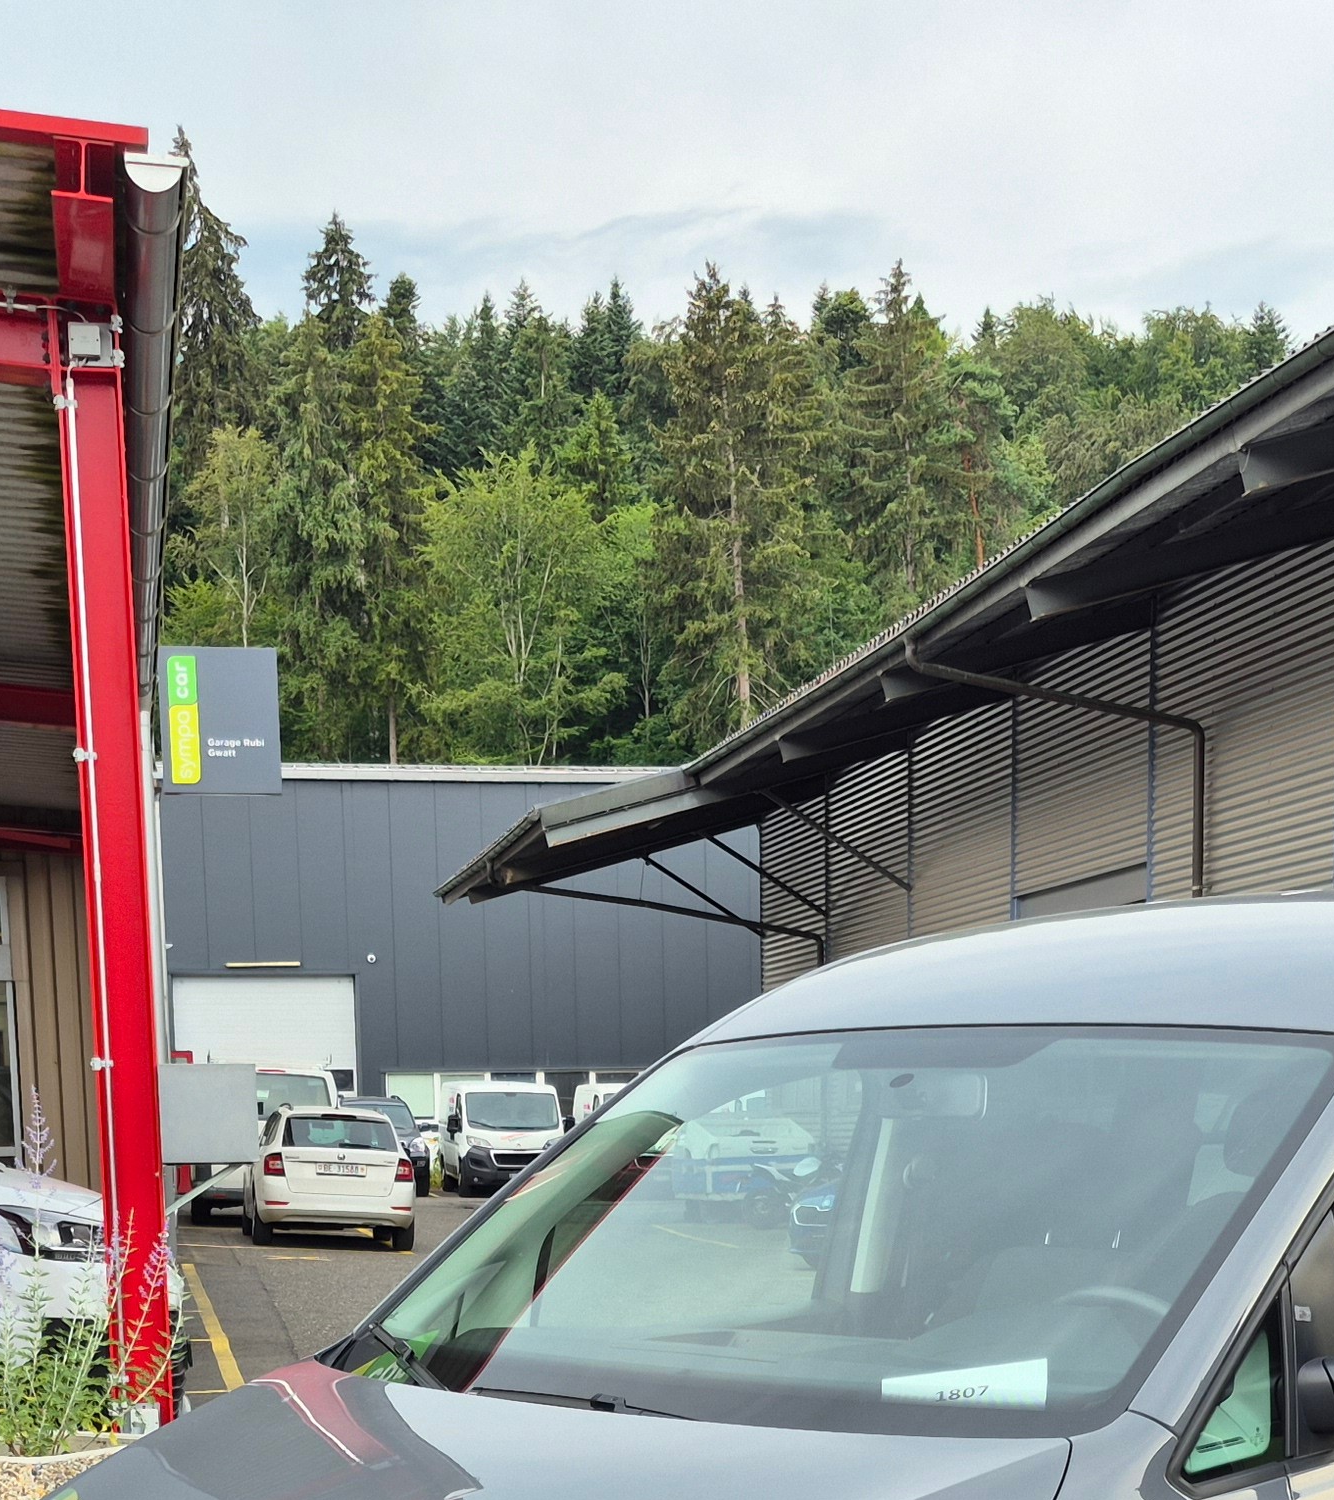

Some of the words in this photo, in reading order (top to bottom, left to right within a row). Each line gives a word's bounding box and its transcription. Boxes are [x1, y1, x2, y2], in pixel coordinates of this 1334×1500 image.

[174, 661, 189, 699] car
[177, 710, 197, 779] sympa
[207, 738, 241, 748] Garage
[243, 738, 265, 747] Rubi
[207, 748, 236, 758] Gwatt
[934, 1385, 989, 1402] 1807
